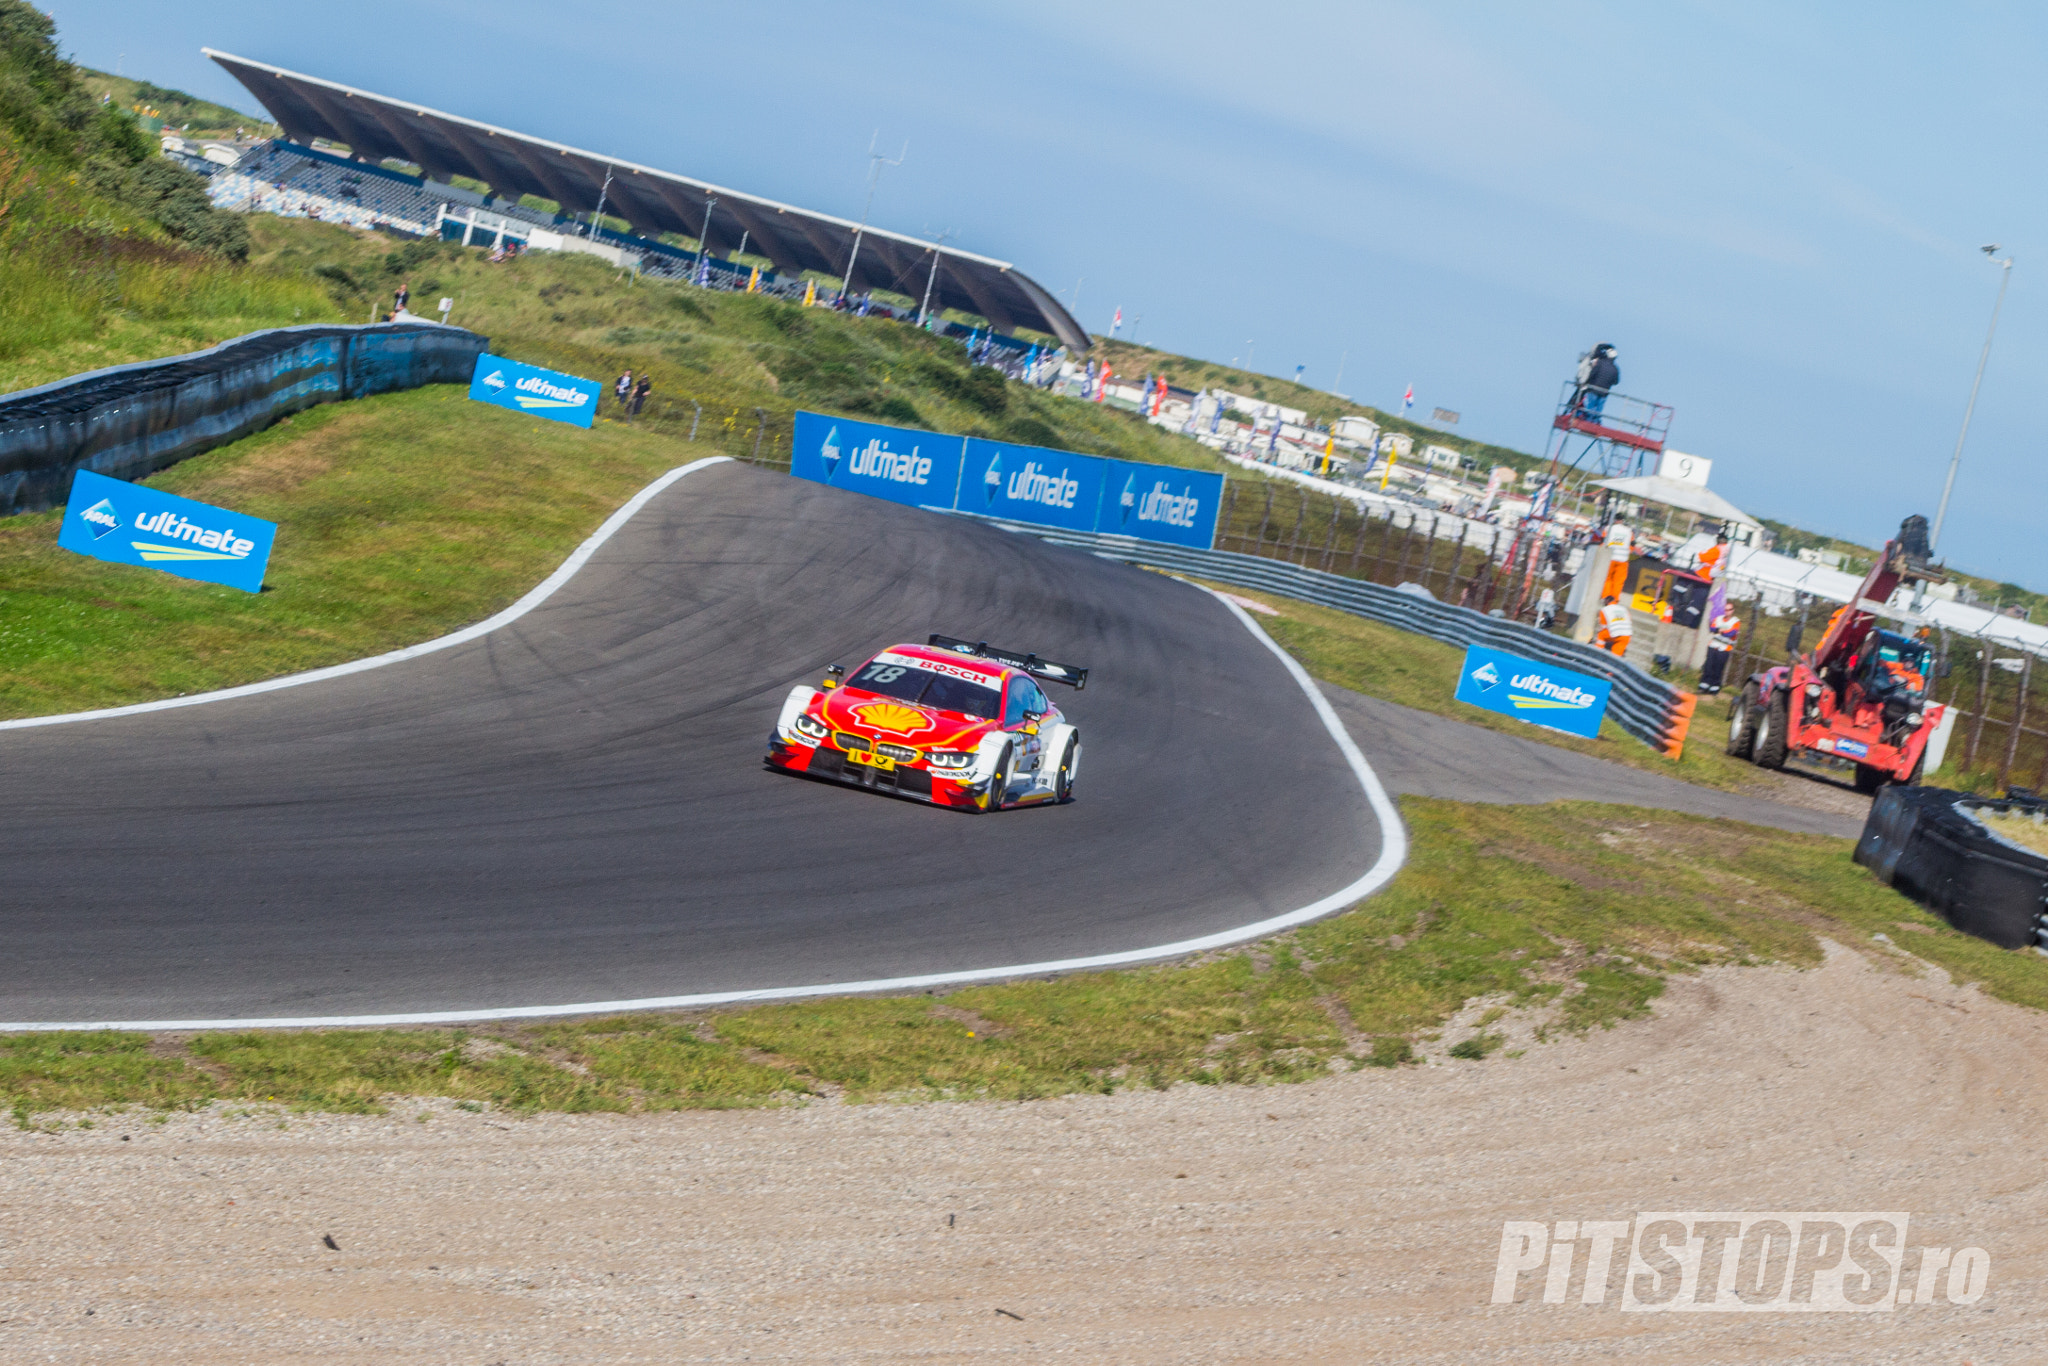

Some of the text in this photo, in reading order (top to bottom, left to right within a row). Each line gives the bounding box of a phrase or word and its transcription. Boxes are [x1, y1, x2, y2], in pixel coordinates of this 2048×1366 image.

[515, 377, 589, 405] ultimate
[849, 438, 932, 486] ultimate
[1679, 457, 1694, 479] 9
[1007, 462, 1079, 509] ultimate
[1138, 481, 1199, 528] ultimate
[83, 510, 255, 557] ARAL ultimate
[861, 664, 907, 684] 18
[919, 660, 988, 684] BOSCH
[1509, 674, 1596, 708] ultimate
